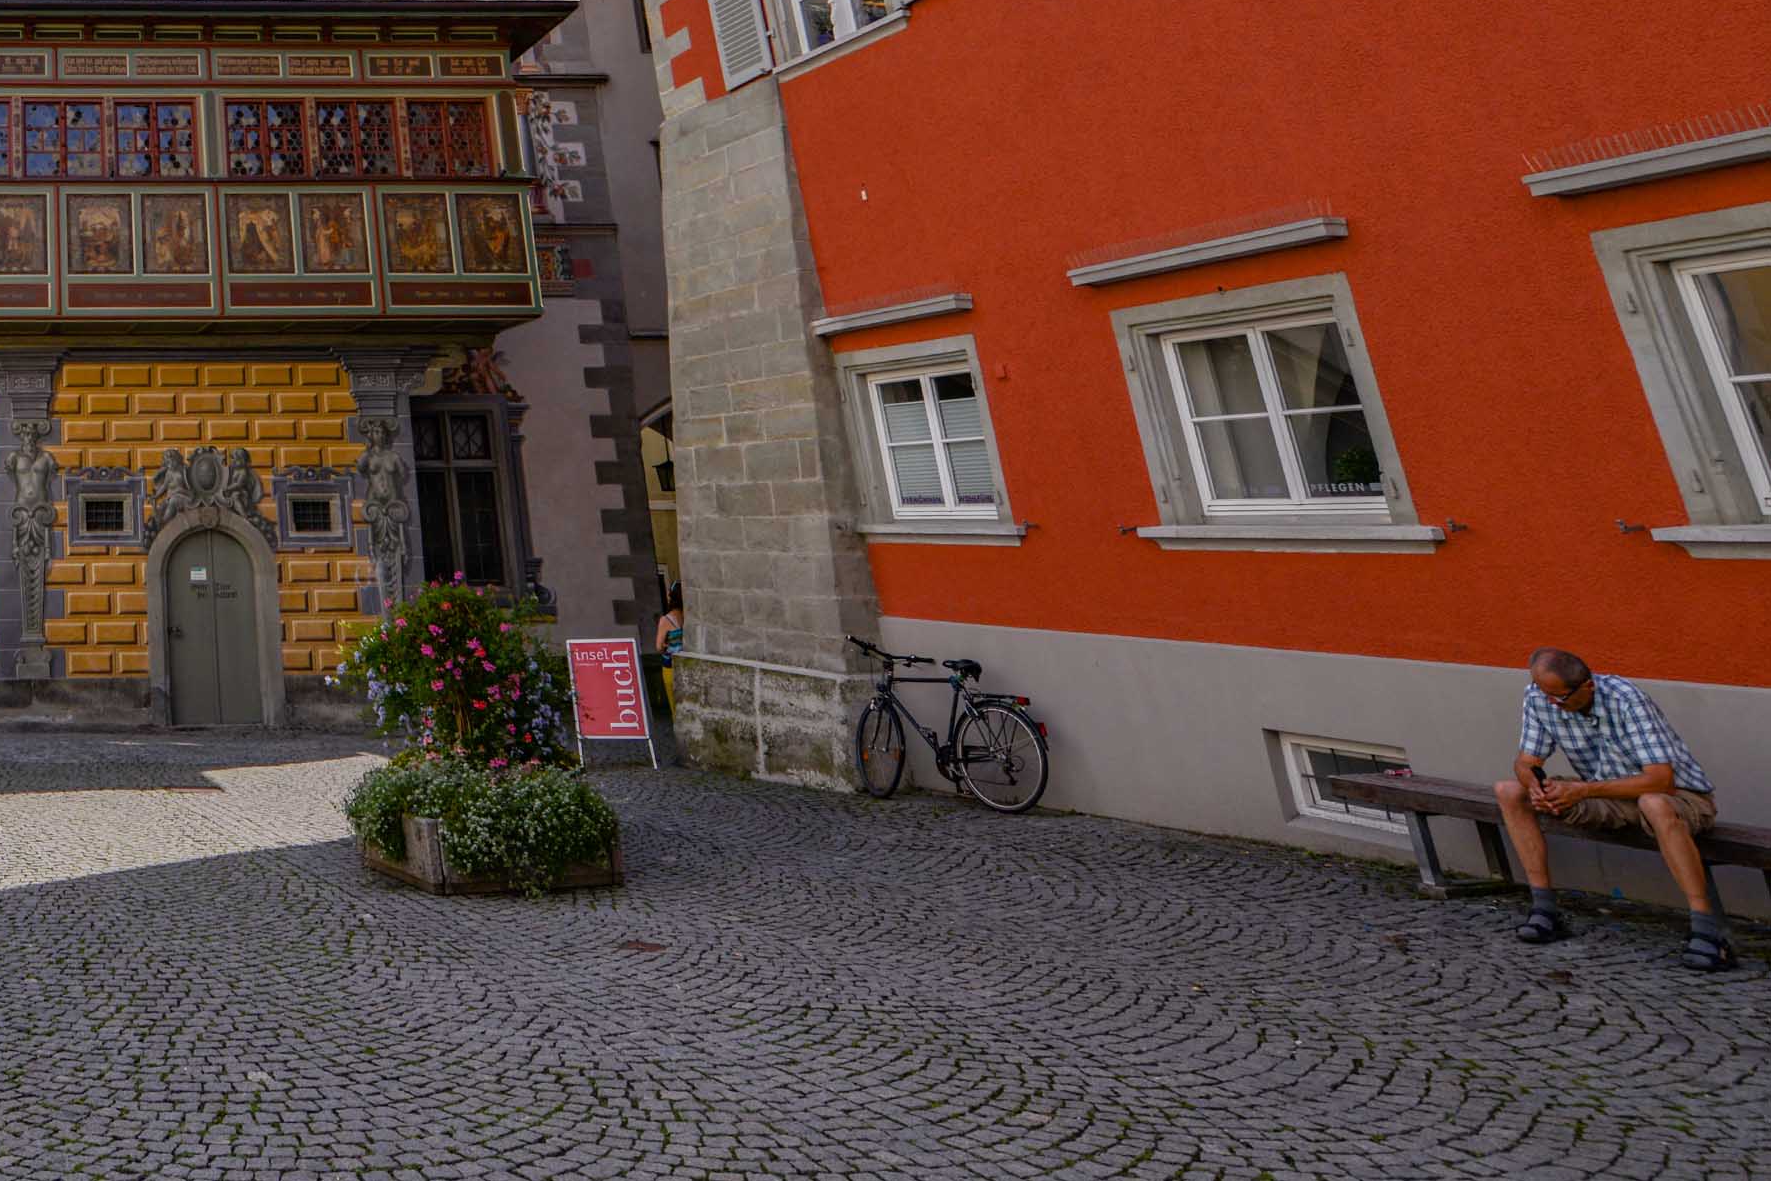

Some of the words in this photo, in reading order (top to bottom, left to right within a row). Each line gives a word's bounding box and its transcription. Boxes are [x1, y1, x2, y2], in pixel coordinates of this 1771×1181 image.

[1310, 482, 1365, 493] PFLEGEN
[574, 647, 610, 661] insel
[602, 648, 640, 731] buch
